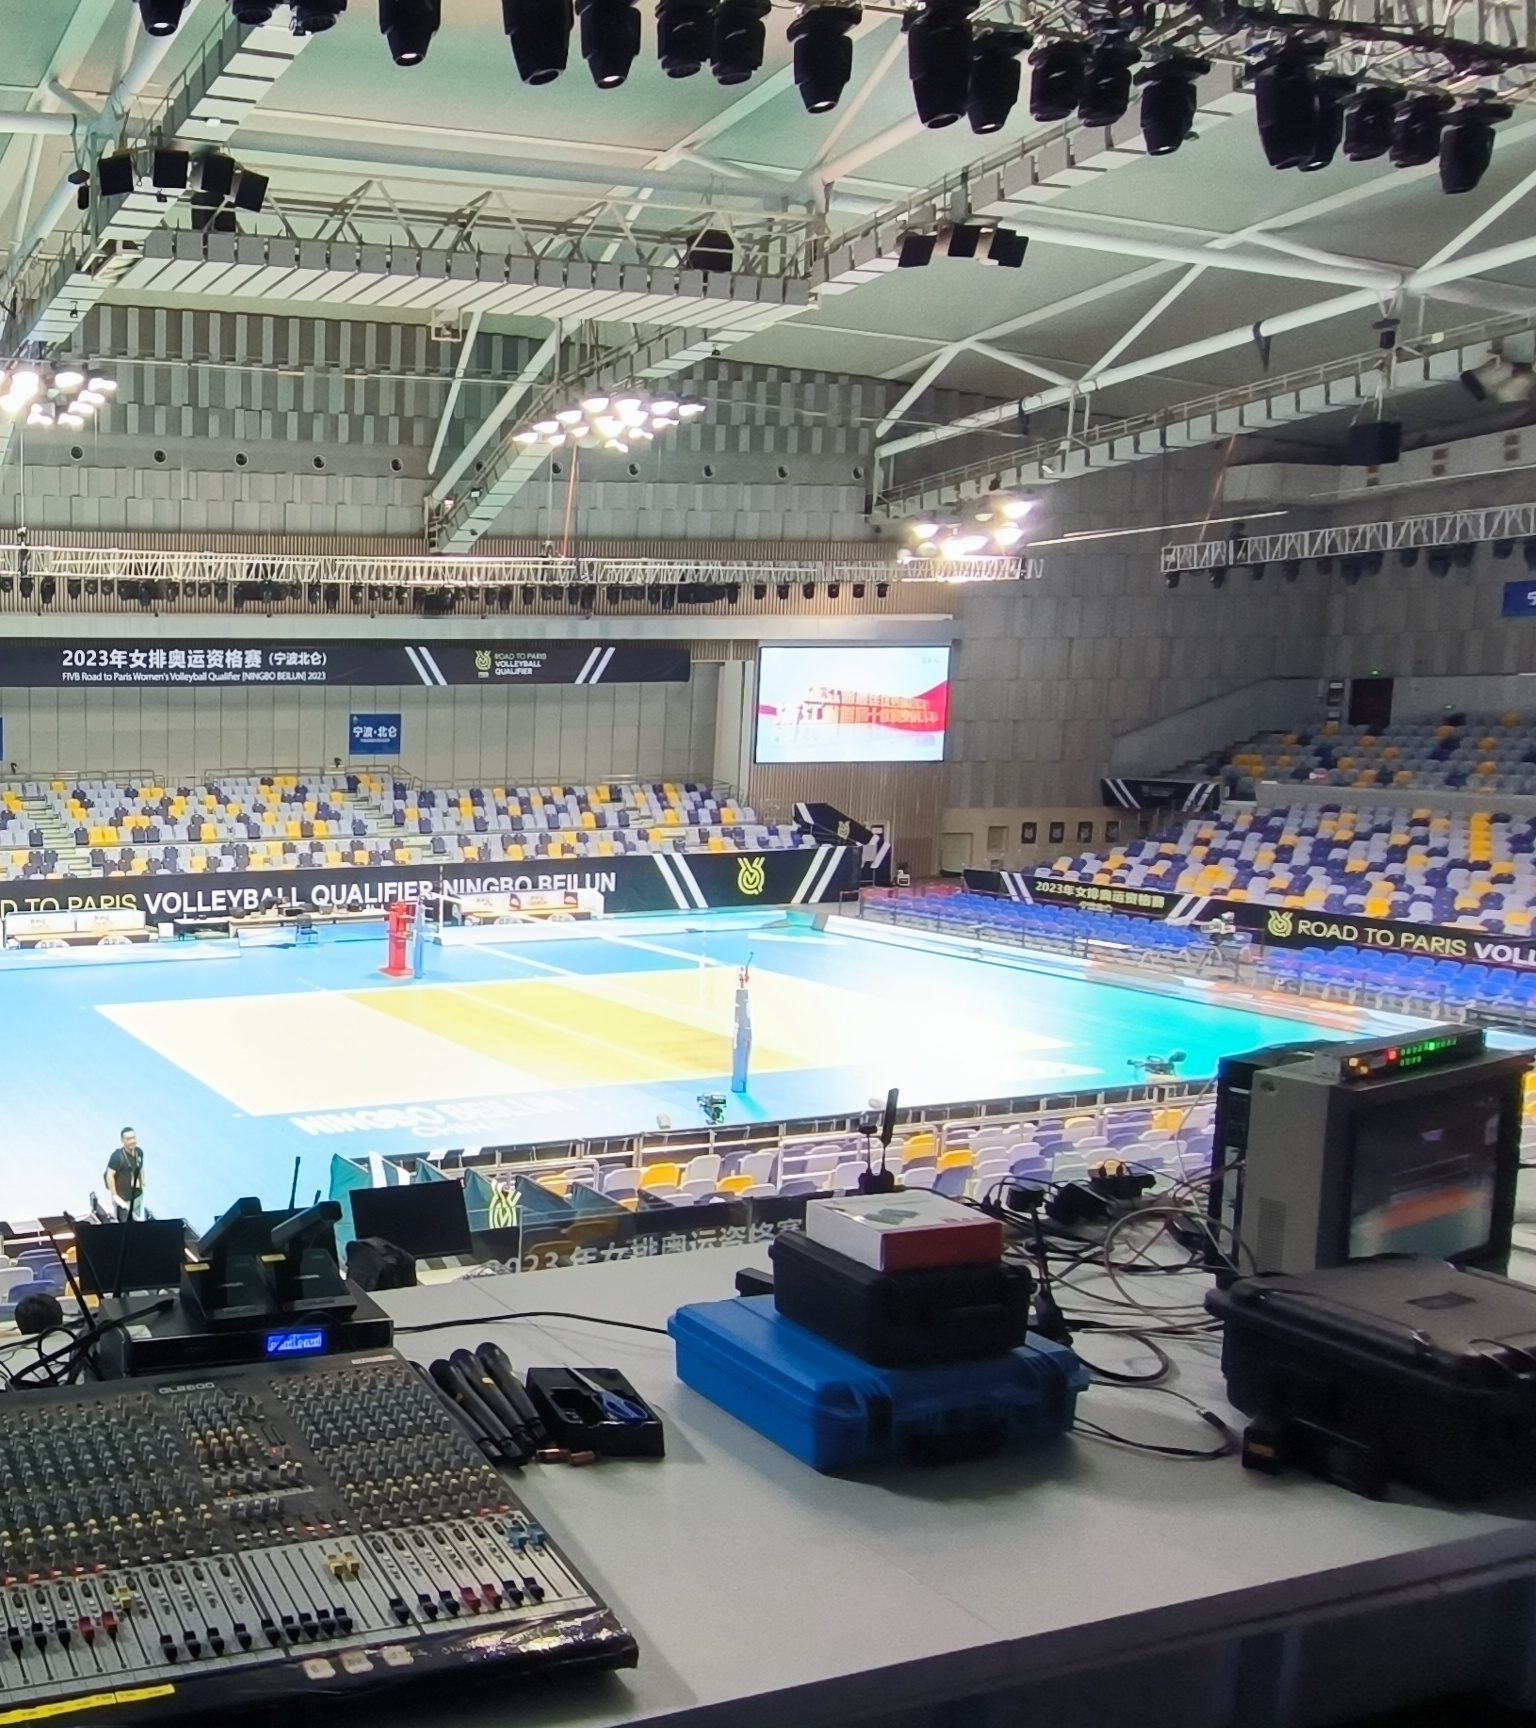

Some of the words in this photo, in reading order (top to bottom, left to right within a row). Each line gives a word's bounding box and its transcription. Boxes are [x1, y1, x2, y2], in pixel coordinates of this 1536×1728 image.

[62, 648, 262, 669] 2023年女排奥运资格赛
[494, 660, 542, 668] VOLLEYBALL
[62, 672, 80, 681] FIVB
[81, 672, 102, 681] Road
[104, 672, 113, 681] to
[114, 672, 132, 681] Paris
[133, 672, 169, 681] Women's
[169, 672, 207, 683] Volleyball
[208, 672, 240, 682] Qualifier
[307, 672, 327, 681] 2023
[494, 668, 533, 676] QUALIFIER
[24, 897, 60, 912] TO
[68, 894, 137, 912] PARIS
[311, 880, 433, 906] QUALIFIER
[443, 876, 533, 896] NINGBO
[538, 872, 616, 892] BEILUN
[1297, 918, 1359, 942] ROAD
[1364, 926, 1395, 947] TO
[1399, 931, 1467, 957] PARIS
[289, 1106, 446, 1136] NINGBO
